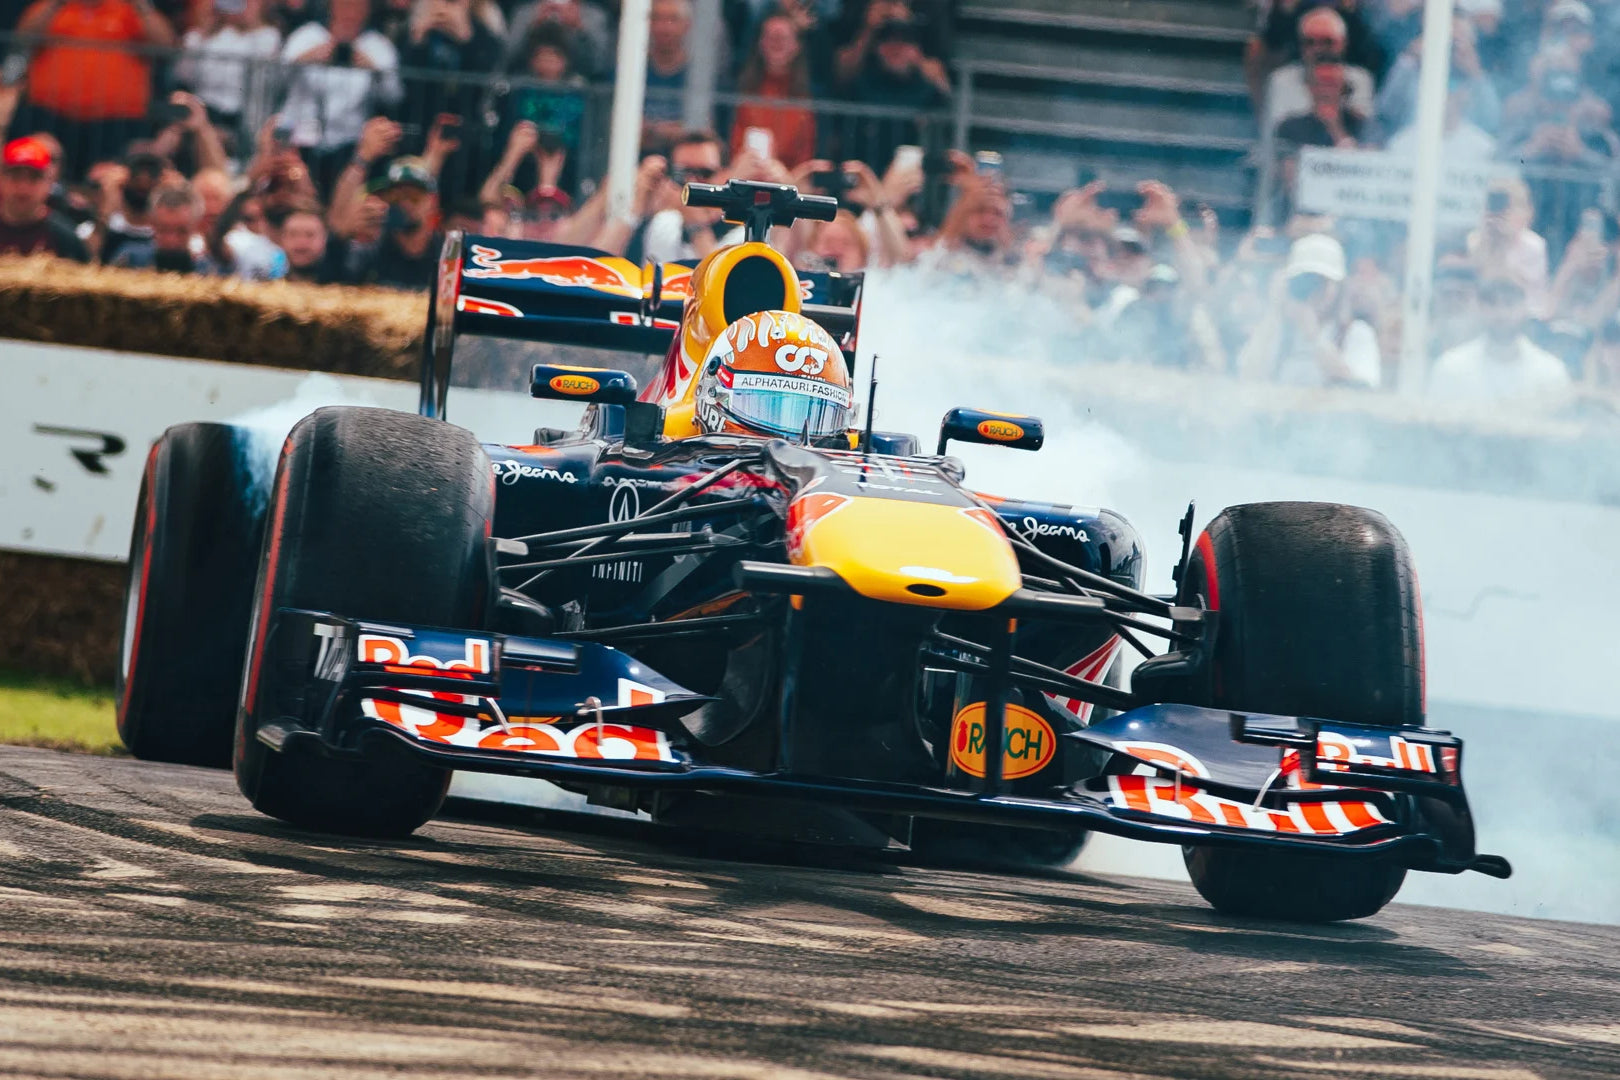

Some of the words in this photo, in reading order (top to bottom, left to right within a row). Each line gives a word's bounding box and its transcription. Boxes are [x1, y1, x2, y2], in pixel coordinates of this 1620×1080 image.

[562, 379, 594, 390] RAUCH
[989, 424, 1018, 437] RAUCH
[968, 722, 1042, 761] RCH
